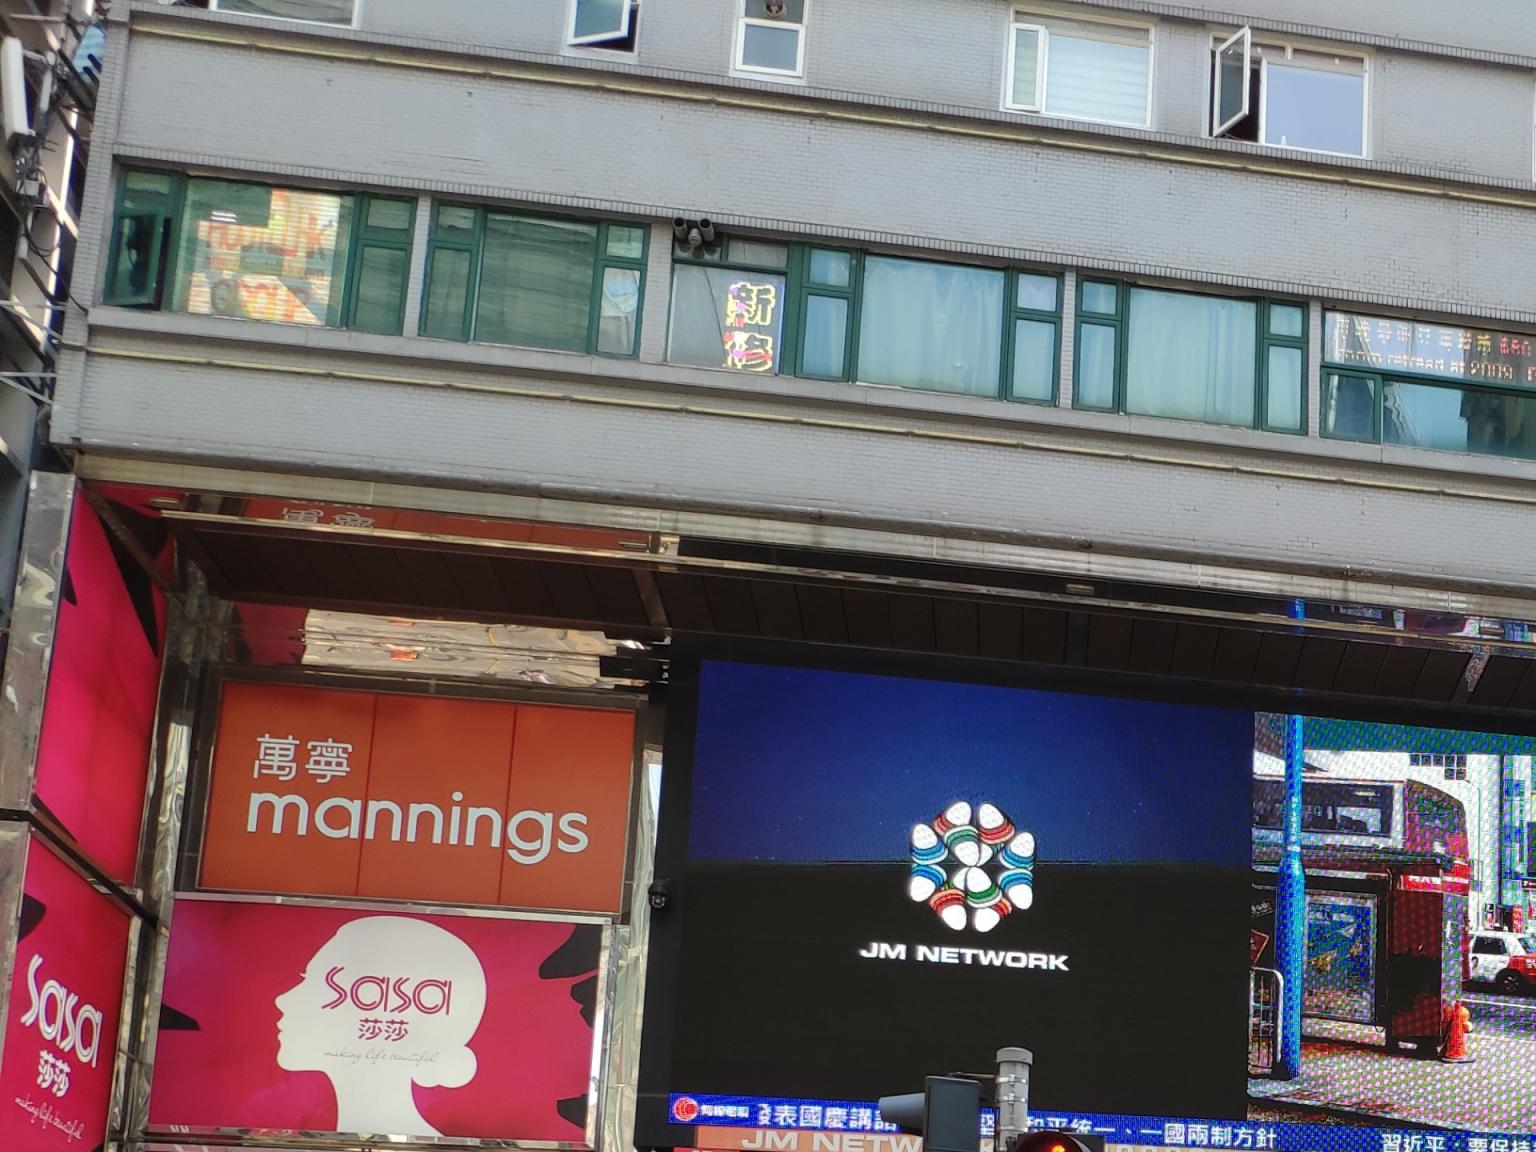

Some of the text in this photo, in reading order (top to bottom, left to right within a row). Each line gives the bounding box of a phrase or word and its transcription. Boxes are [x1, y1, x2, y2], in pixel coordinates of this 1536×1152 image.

[252, 733, 353, 784] 萬寧
[246, 791, 590, 864] mannings
[860, 942, 1070, 972] JM NETWORK
[358, 1018, 409, 1041] 莎莎
[37, 1050, 71, 1098] 莎莎
[741, 1131, 798, 1149] JM
